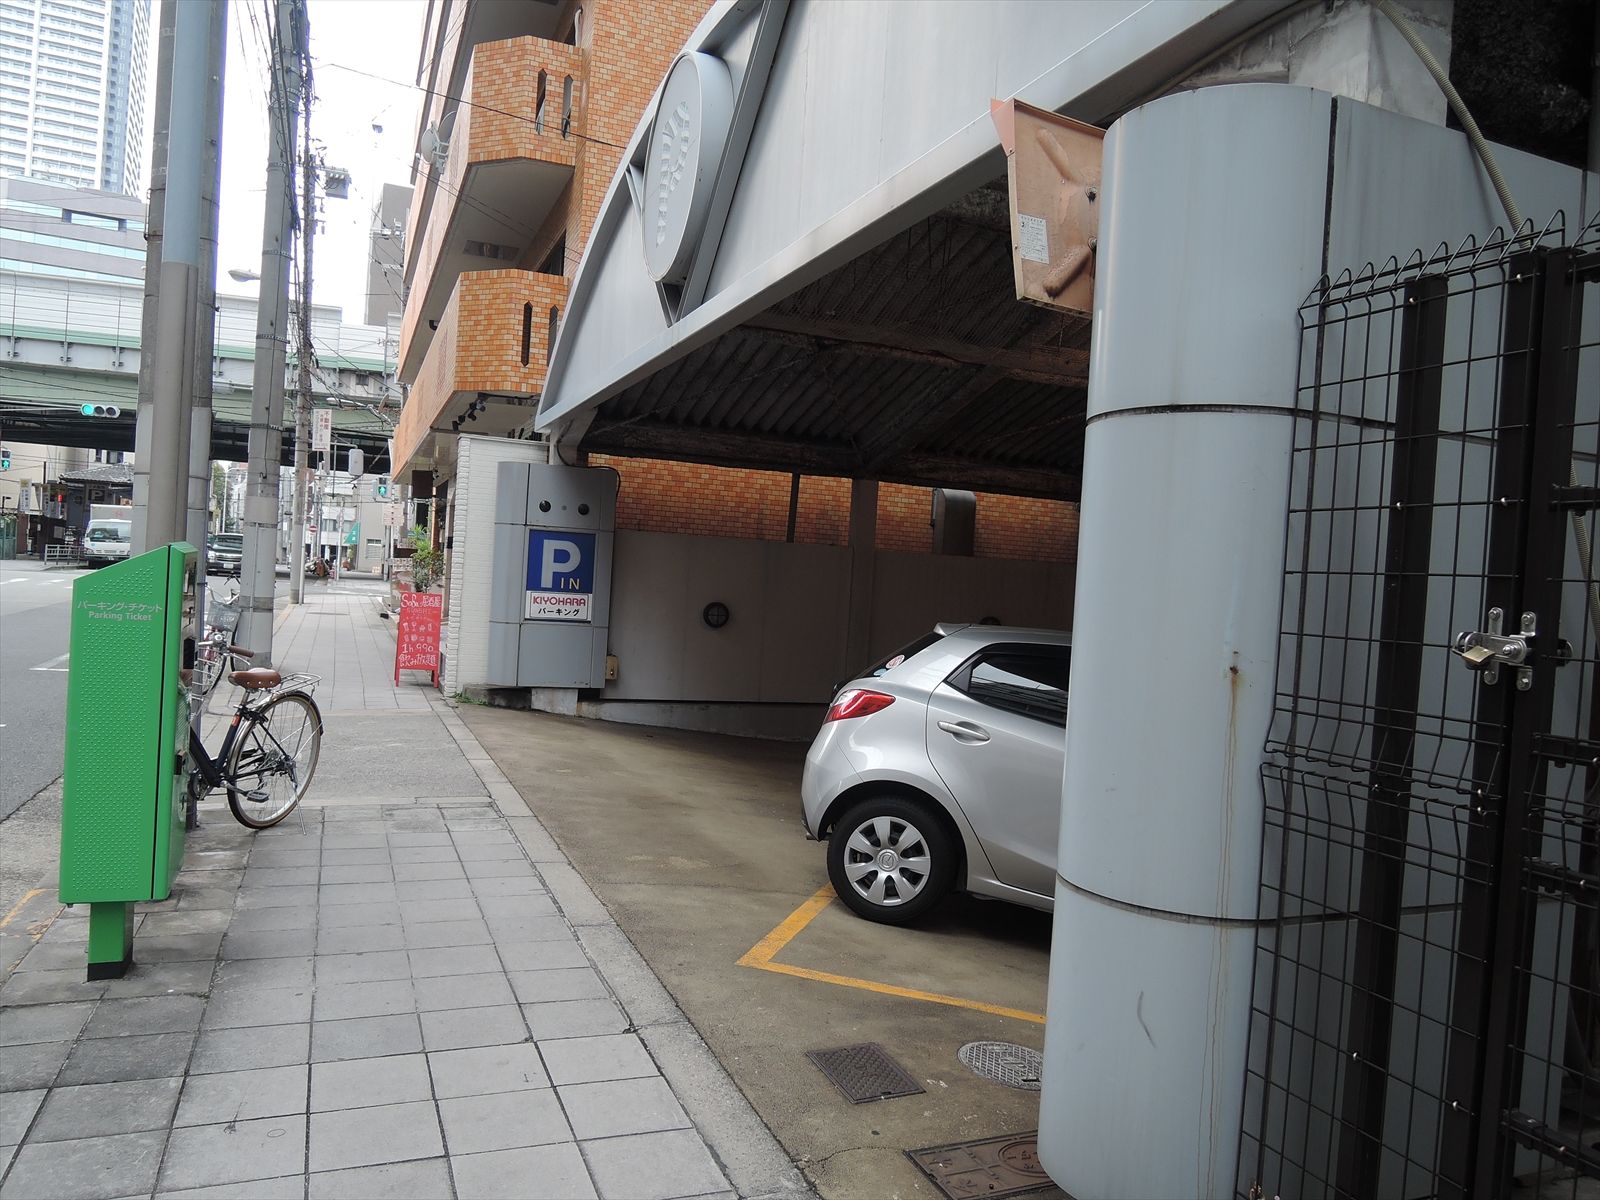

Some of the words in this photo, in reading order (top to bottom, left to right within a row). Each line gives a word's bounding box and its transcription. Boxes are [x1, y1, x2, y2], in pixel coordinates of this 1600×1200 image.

[541, 539, 581, 588] P
[560, 577, 580, 590] IN
[532, 596, 586, 607] KIYOHARA
[88, 611, 123, 621] Parking
[126, 612, 153, 621] Ticket
[538, 607, 580, 617] パーキング
